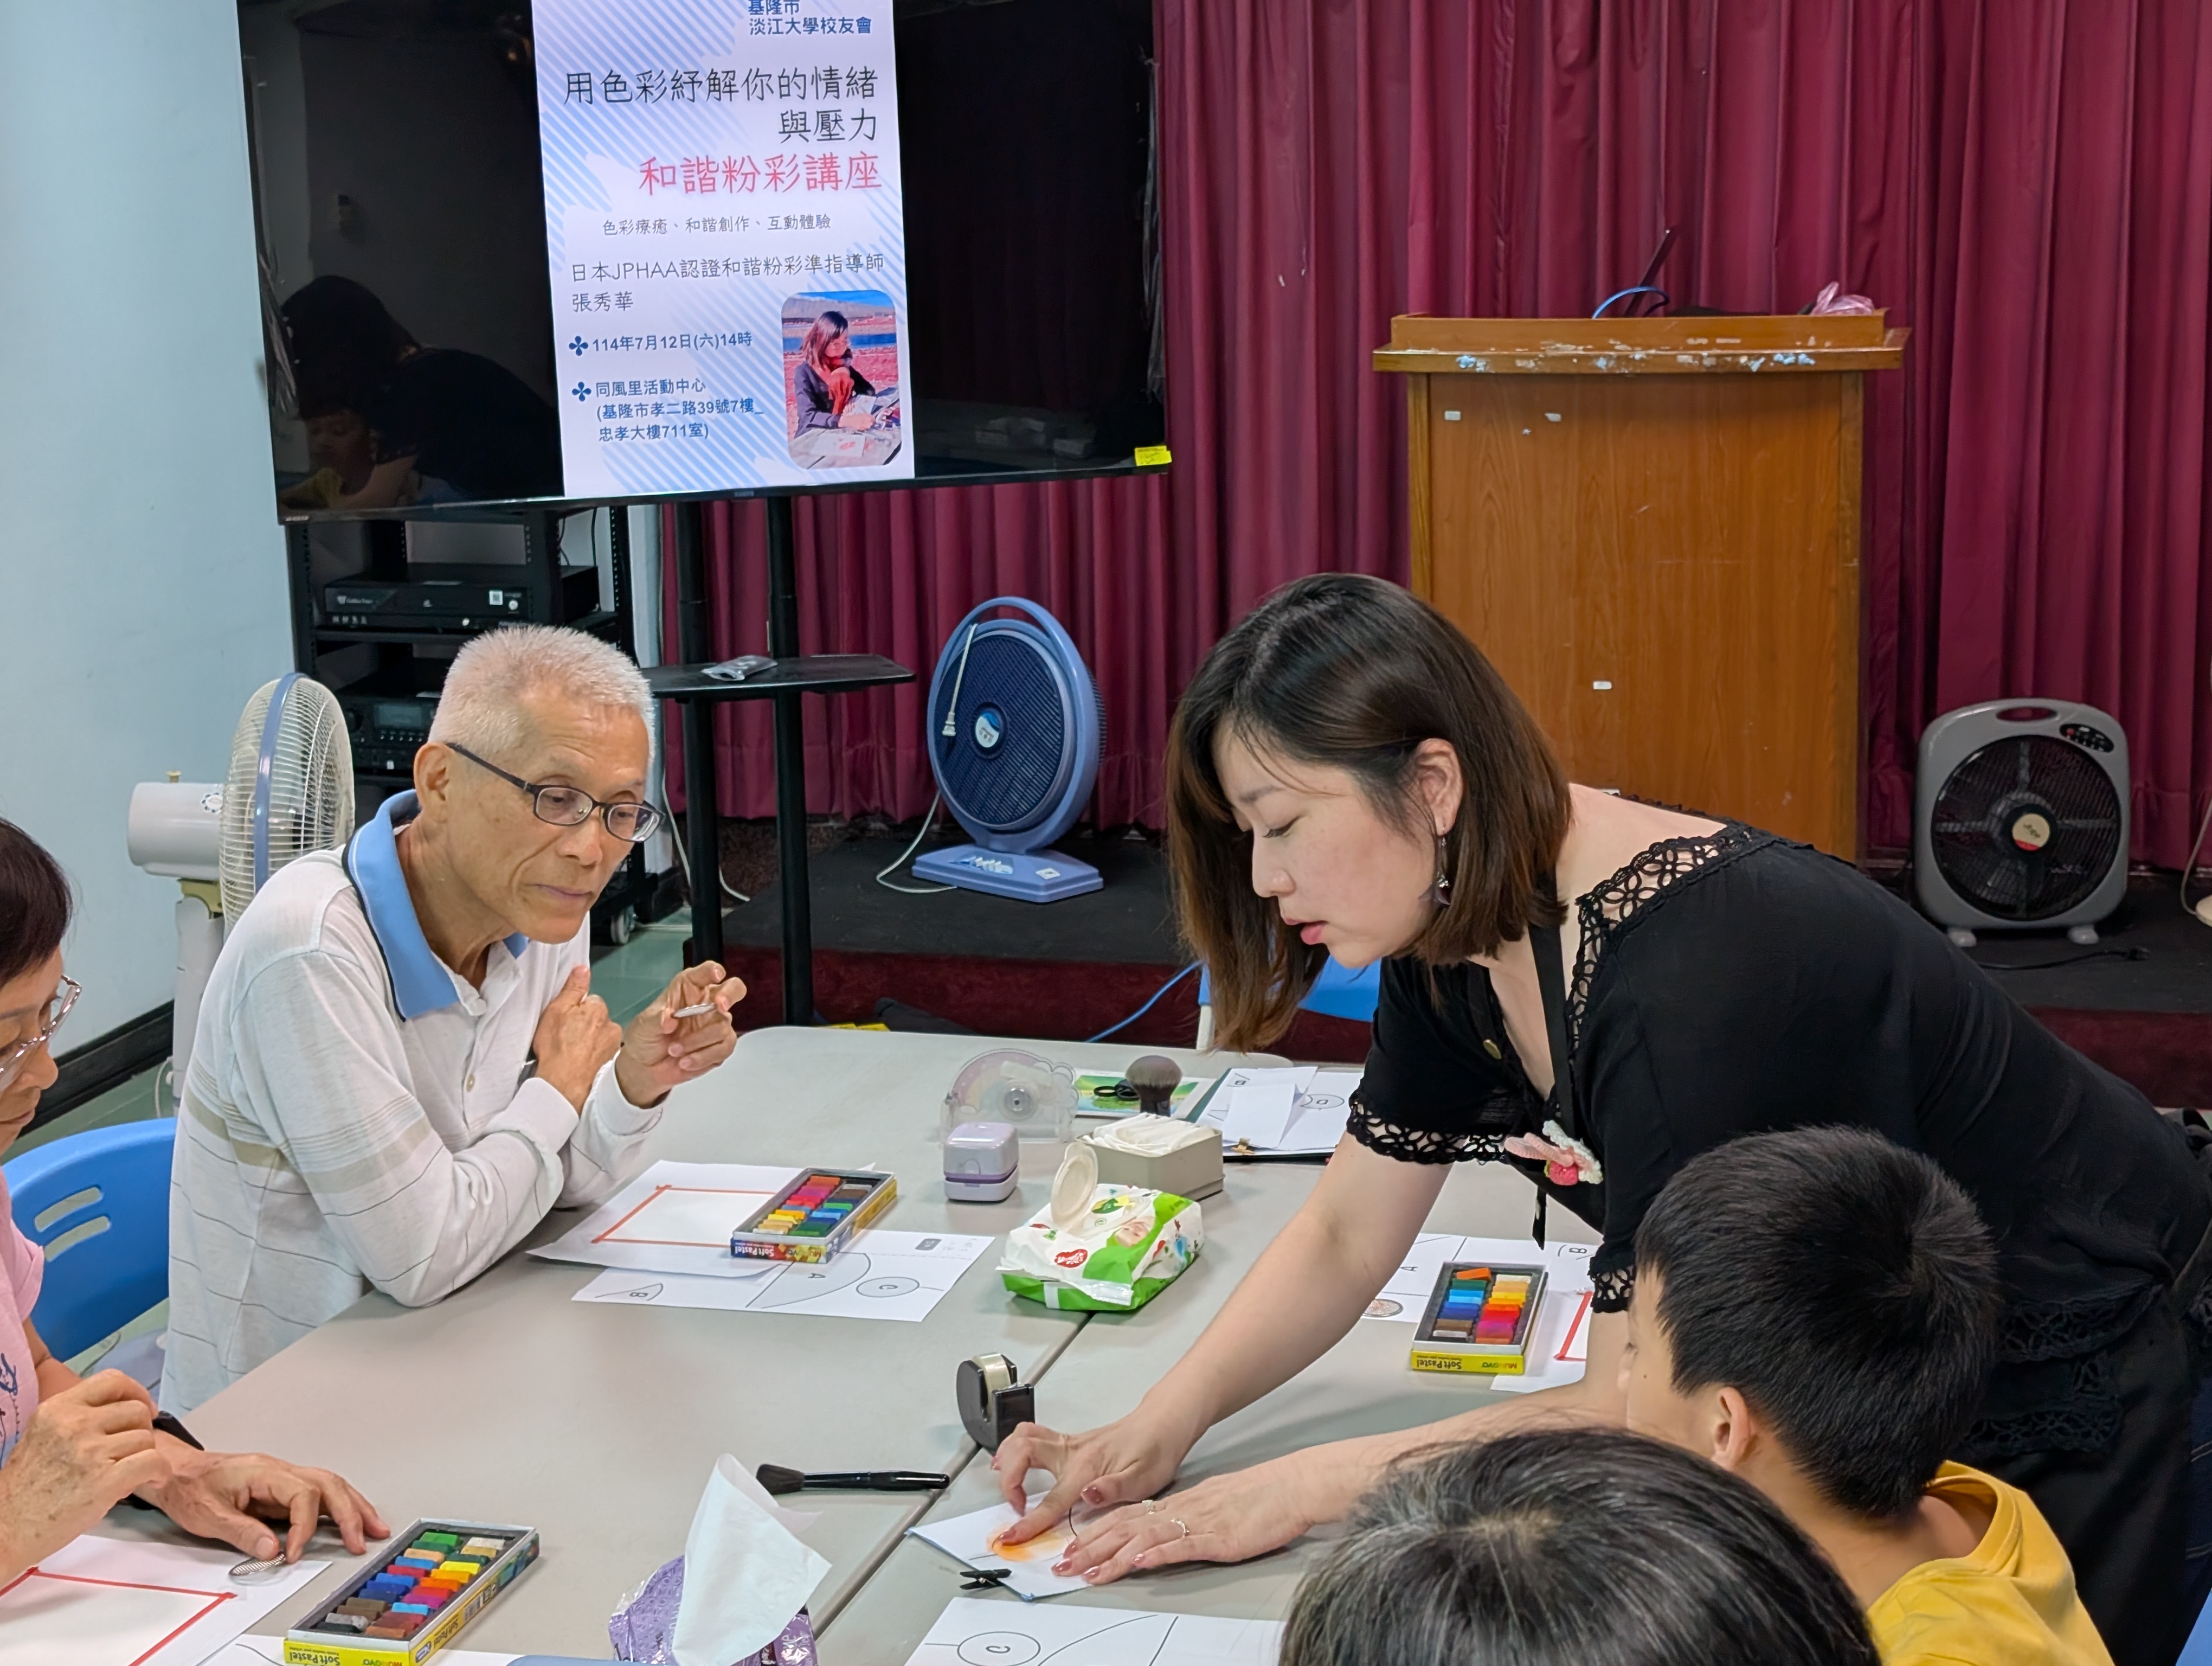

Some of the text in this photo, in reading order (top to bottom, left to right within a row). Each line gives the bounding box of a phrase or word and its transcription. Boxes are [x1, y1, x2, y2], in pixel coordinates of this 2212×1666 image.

[748, 0, 800, 15] 基隆市
[749, 16, 872, 35] 淡江大學校友會
[564, 66, 878, 104] 用色彩紓解你的情緒
[779, 108, 876, 143] 與壓力
[640, 151, 882, 195] 和諧粉彩講座
[572, 254, 883, 281] 日本JPHAA認證和諧粉彩準指導師
[572, 291, 633, 312] 張秀華
[593, 331, 751, 351] 114年7月12日(六)14時
[596, 379, 705, 398] 同風里活動中心
[599, 423, 709, 441] 忠孝大樓711室)
[1417, 1359, 1462, 1369] Soft Pastel
[290, 1652, 340, 1666] Soft Pastel
